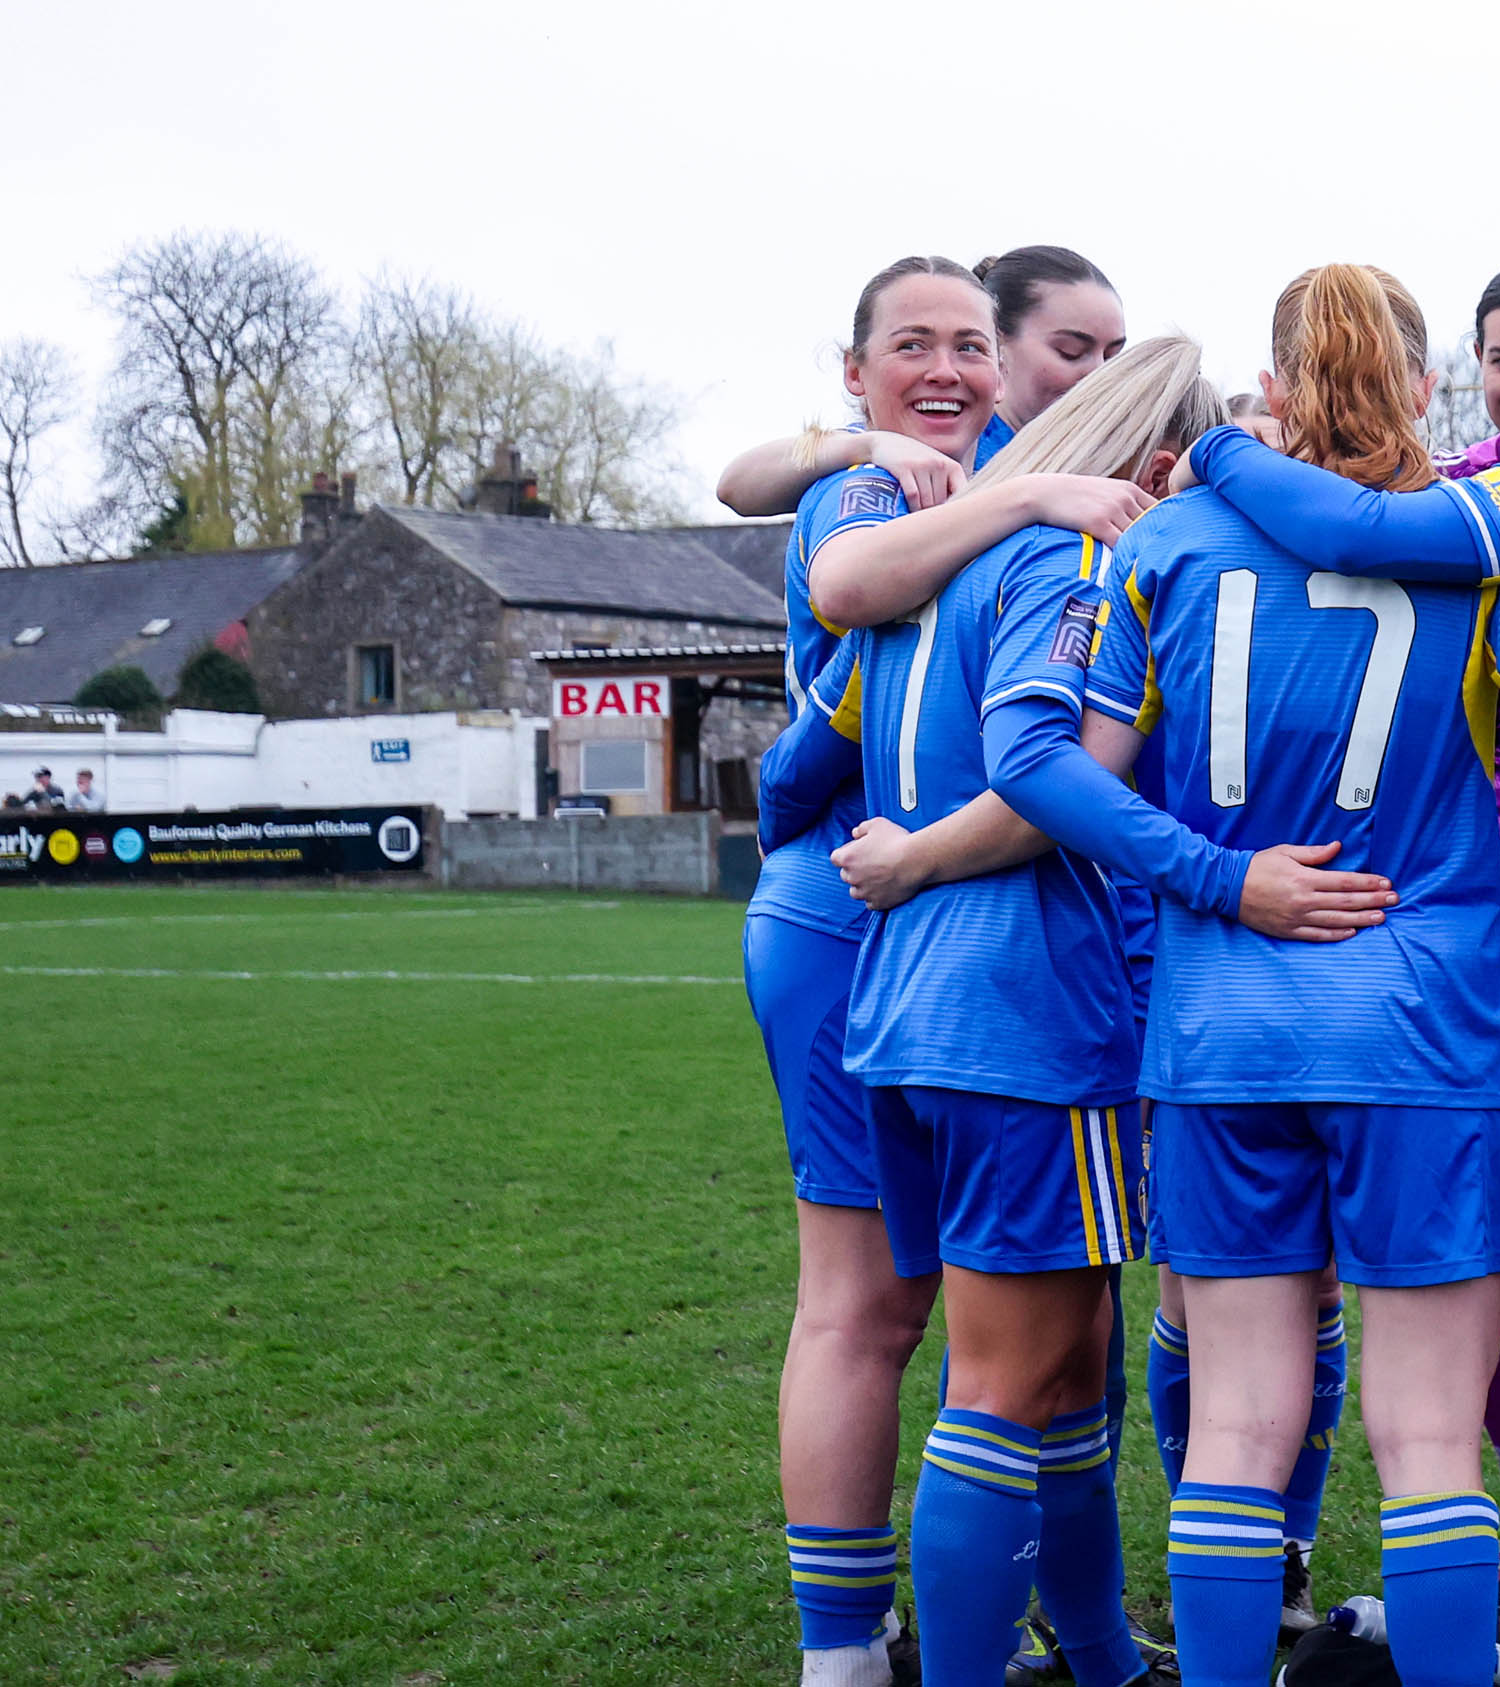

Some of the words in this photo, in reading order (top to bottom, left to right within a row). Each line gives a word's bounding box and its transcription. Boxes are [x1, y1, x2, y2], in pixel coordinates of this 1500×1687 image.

[561, 681, 661, 715] BAR
[1209, 567, 1417, 812] 17
[149, 825, 216, 842] Bauformat
[216, 823, 263, 842] Quality
[263, 822, 314, 839] German
[315, 820, 372, 837] Kitchens
[150, 847, 303, 864] www.clearlyinteriors.com
